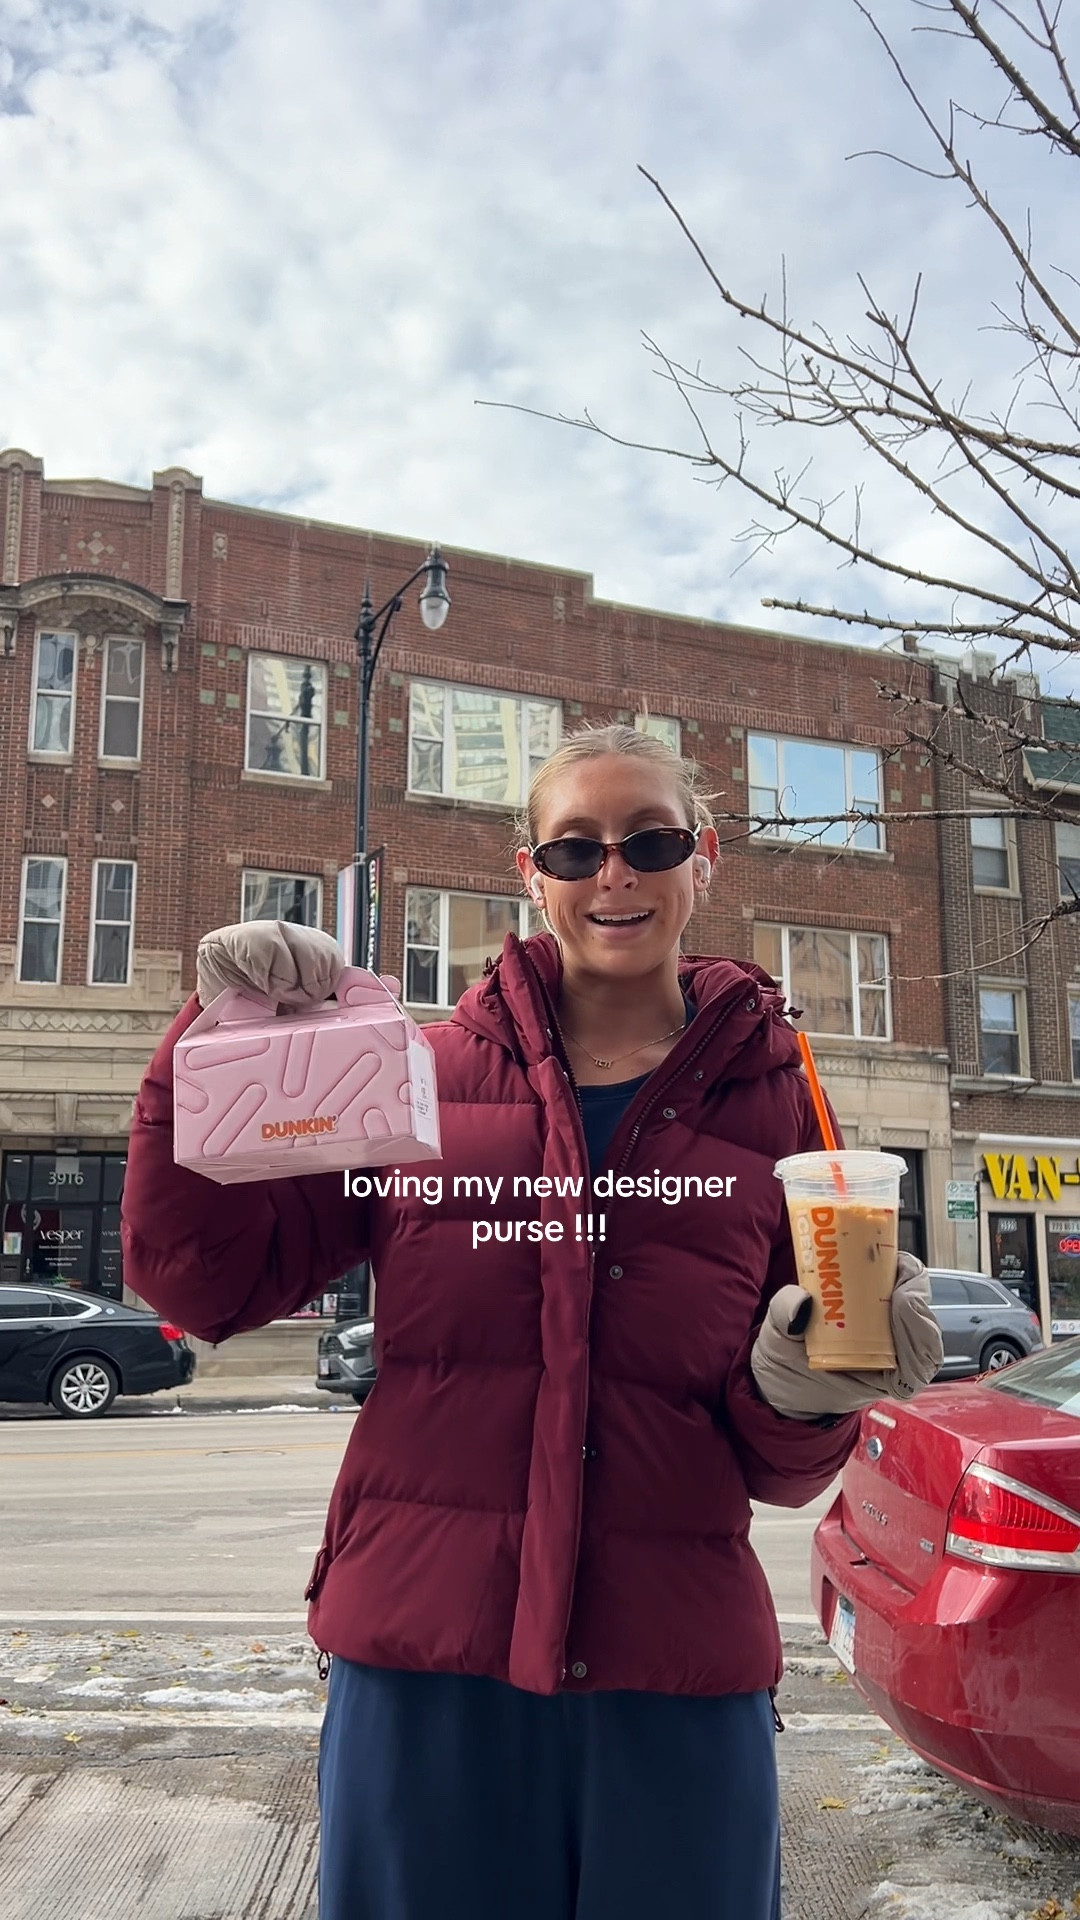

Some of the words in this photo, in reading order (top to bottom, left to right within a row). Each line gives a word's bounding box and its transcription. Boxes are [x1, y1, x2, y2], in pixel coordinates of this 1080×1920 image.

[262, 1116, 337, 1139] DUNKIN'
[48, 1171, 84, 1185] 3916
[983, 1153, 1080, 1201] VAN-
[1059, 1239, 1080, 1253] OPE
[811, 1207, 845, 1328] DUNKIN'
